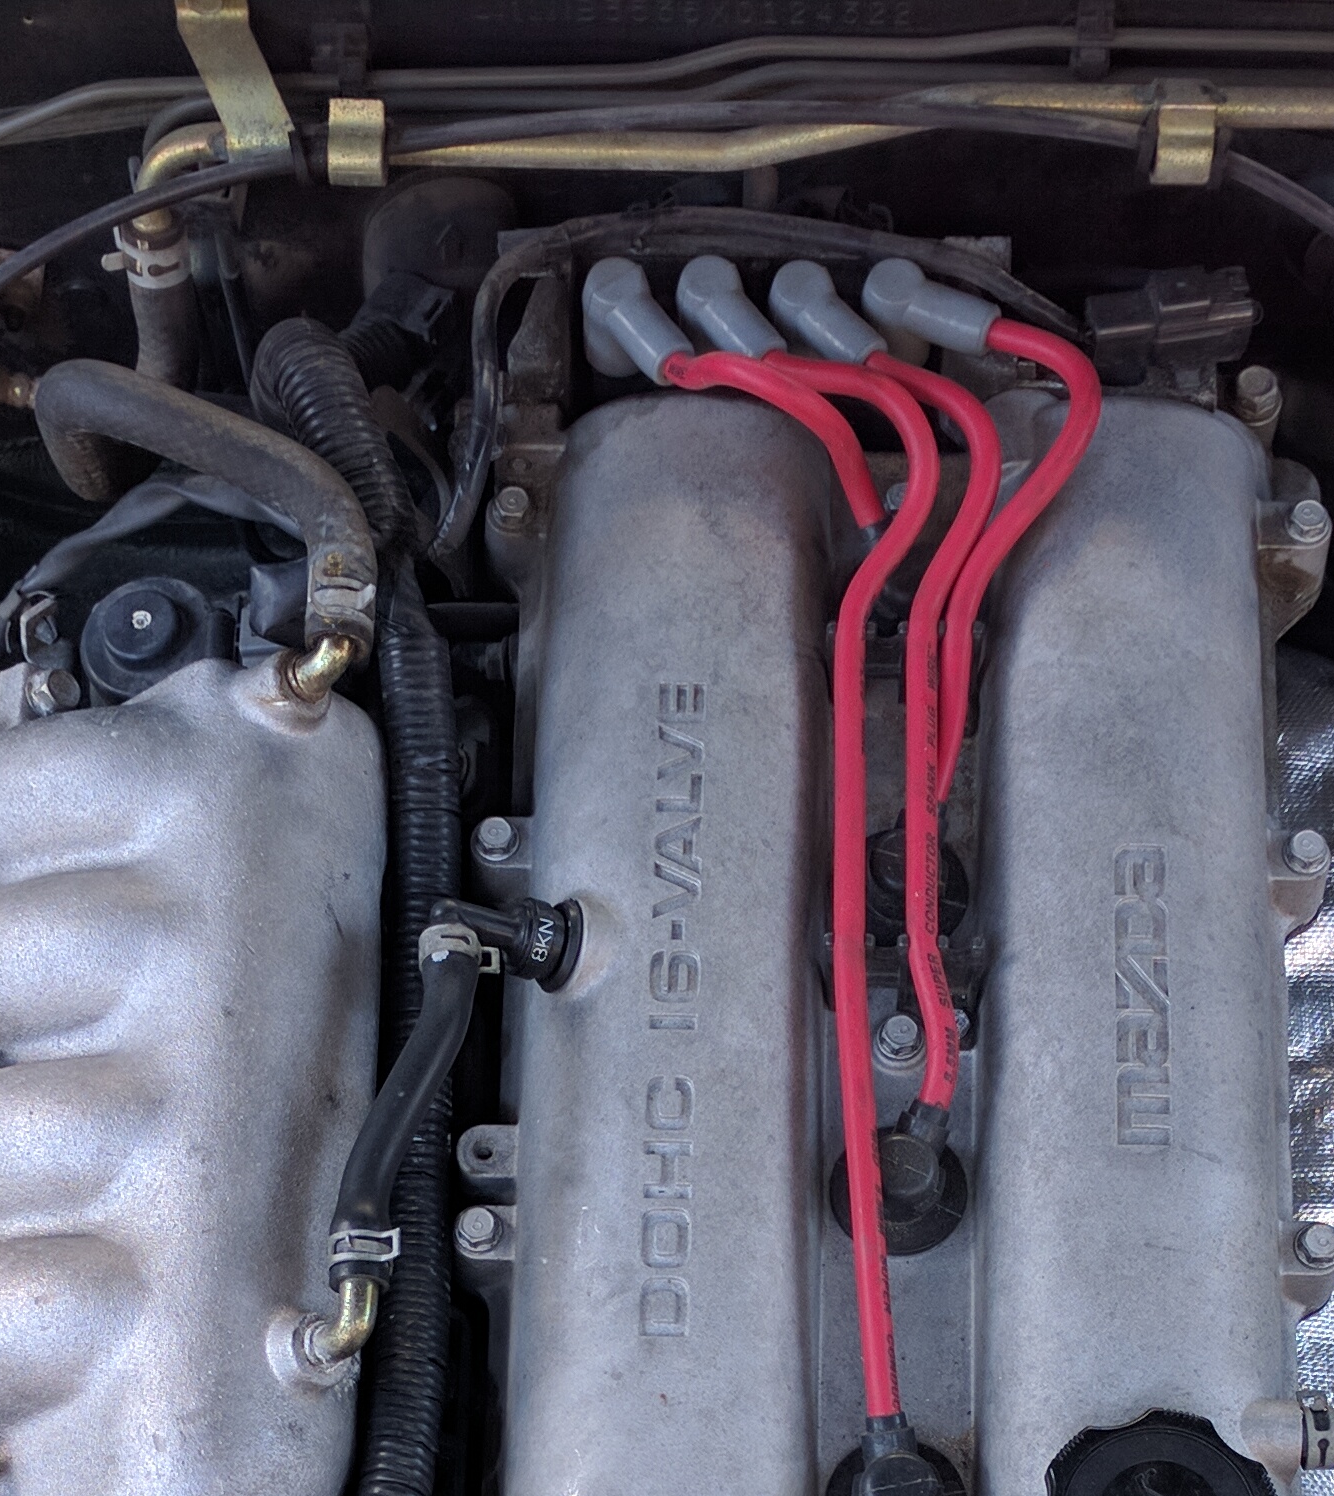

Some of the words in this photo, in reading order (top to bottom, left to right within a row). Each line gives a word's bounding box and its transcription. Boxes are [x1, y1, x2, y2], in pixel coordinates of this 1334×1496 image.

[927, 704, 935, 749] PLUG
[926, 761, 935, 817] SPARK
[649, 682, 707, 1031] 16-VALVE
[924, 831, 936, 935] CONDUCTOR
[531, 917, 554, 963] 8KN
[928, 952, 949, 1007] SUPER
[640, 1075, 696, 1338] DOHC
